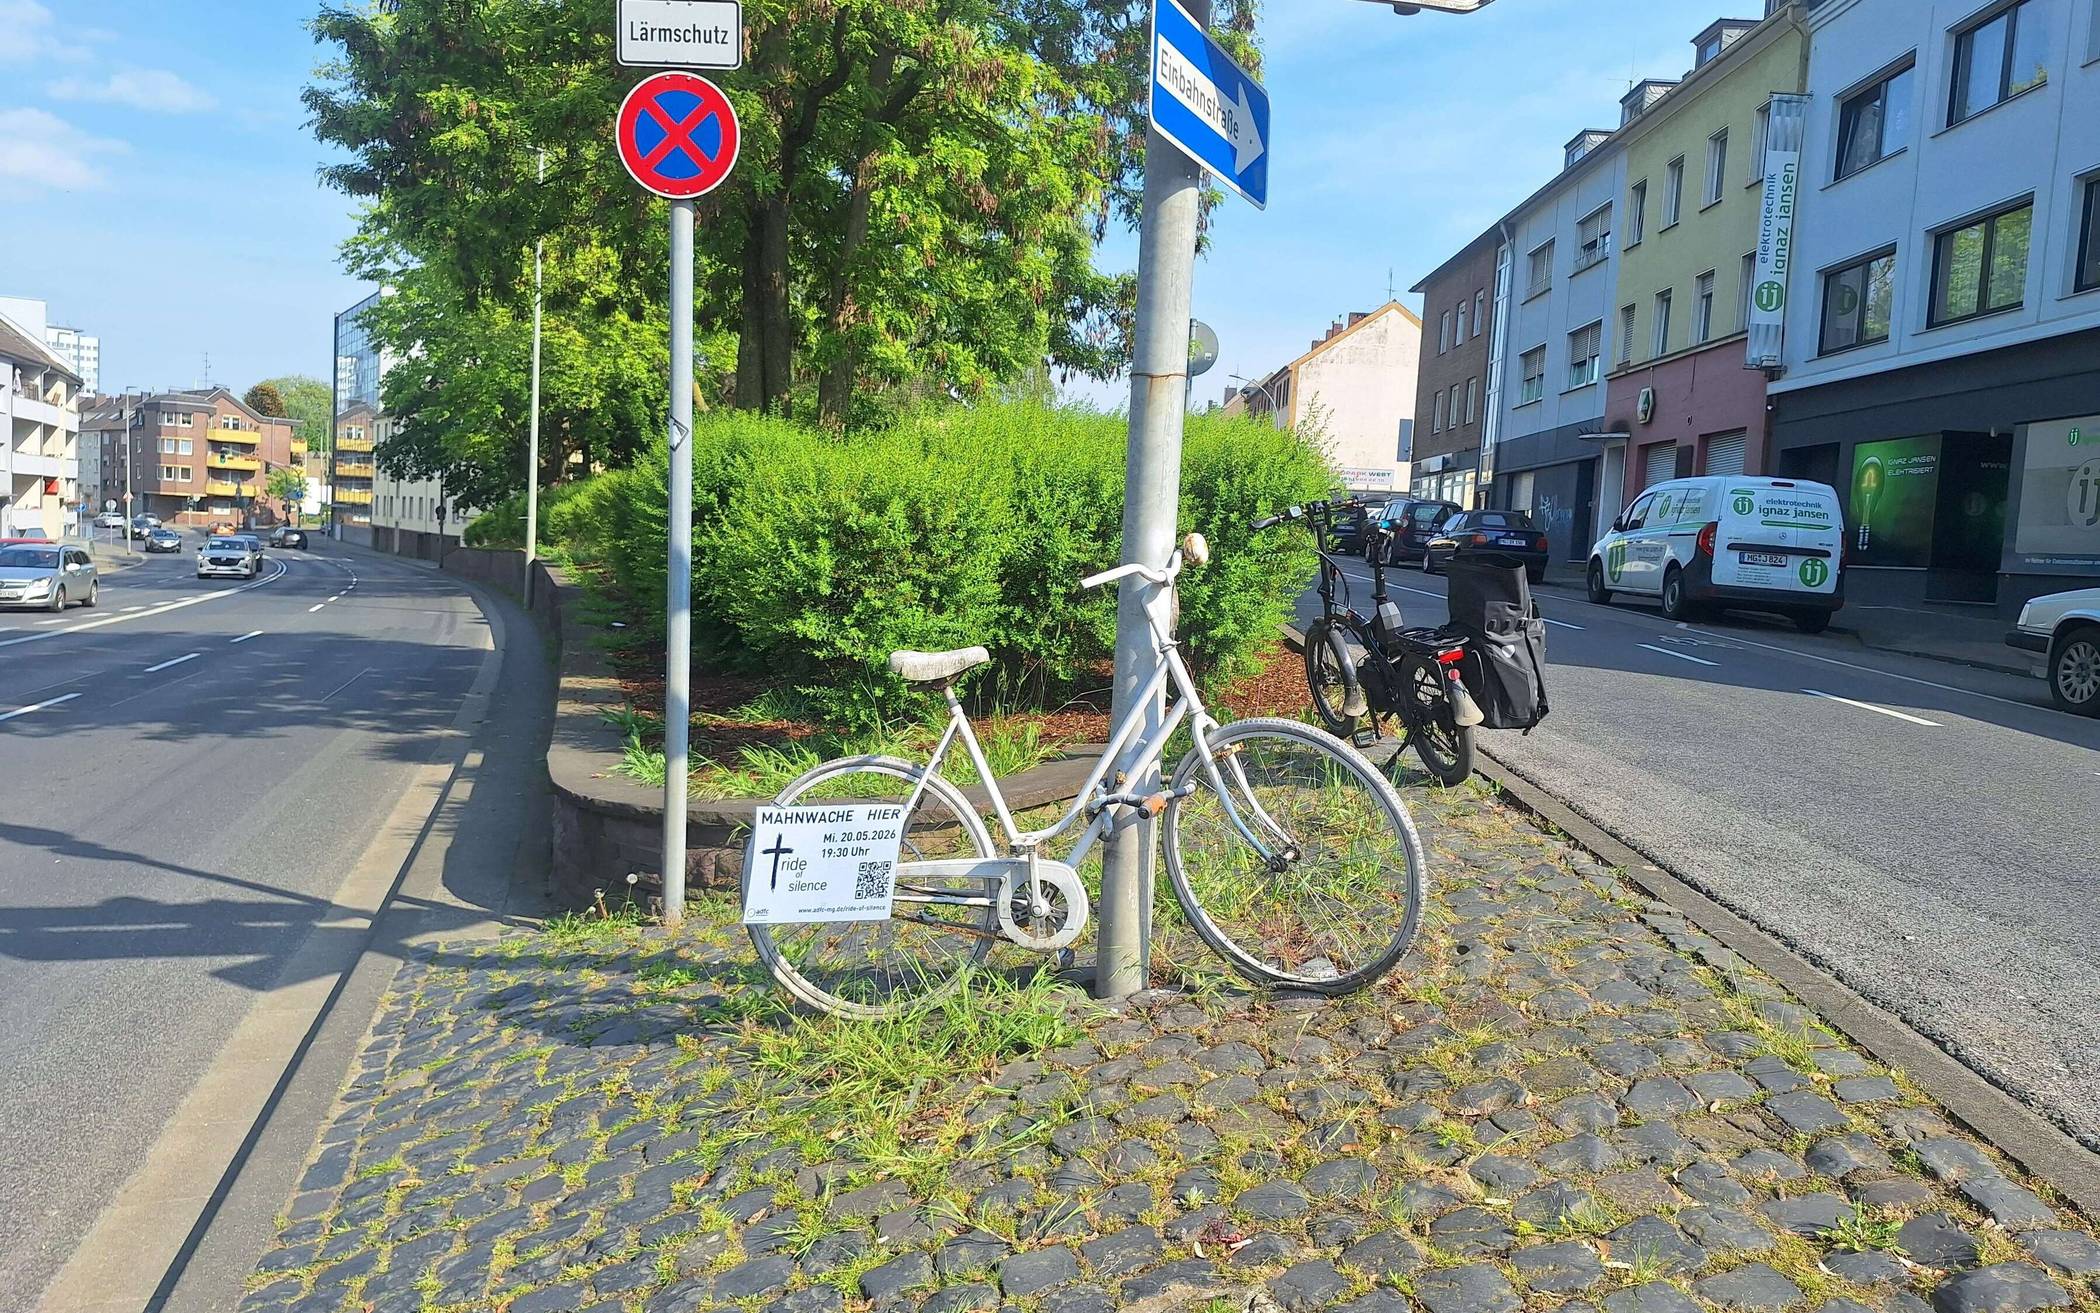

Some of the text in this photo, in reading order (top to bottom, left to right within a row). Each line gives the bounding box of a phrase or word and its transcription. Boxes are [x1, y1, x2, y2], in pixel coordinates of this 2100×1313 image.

[629, 20, 729, 47] Lärmschutz
[1161, 48, 1239, 140] Einbahnstraße
[1760, 172, 1777, 264] elektrotechnik
[1761, 283, 1778, 311] ij
[1908, 455, 1936, 464] JANSEN
[1738, 497, 1749, 514] ij
[1766, 497, 1823, 509] elektrotechnik
[1758, 504, 1829, 520] ignaz jansen
[1805, 560, 1822, 585] ij
[762, 808, 901, 824] MAHNWACHE HIER
[823, 829, 896, 843] Mi. 20.05.2026
[821, 847, 870, 858] 19:30 Uhr
[781, 857, 808, 871] ride
[795, 871, 803, 879] of
[788, 880, 828, 892] silence
[798, 905, 887, 914] www.adfc-mg.de/ride-of-silence
